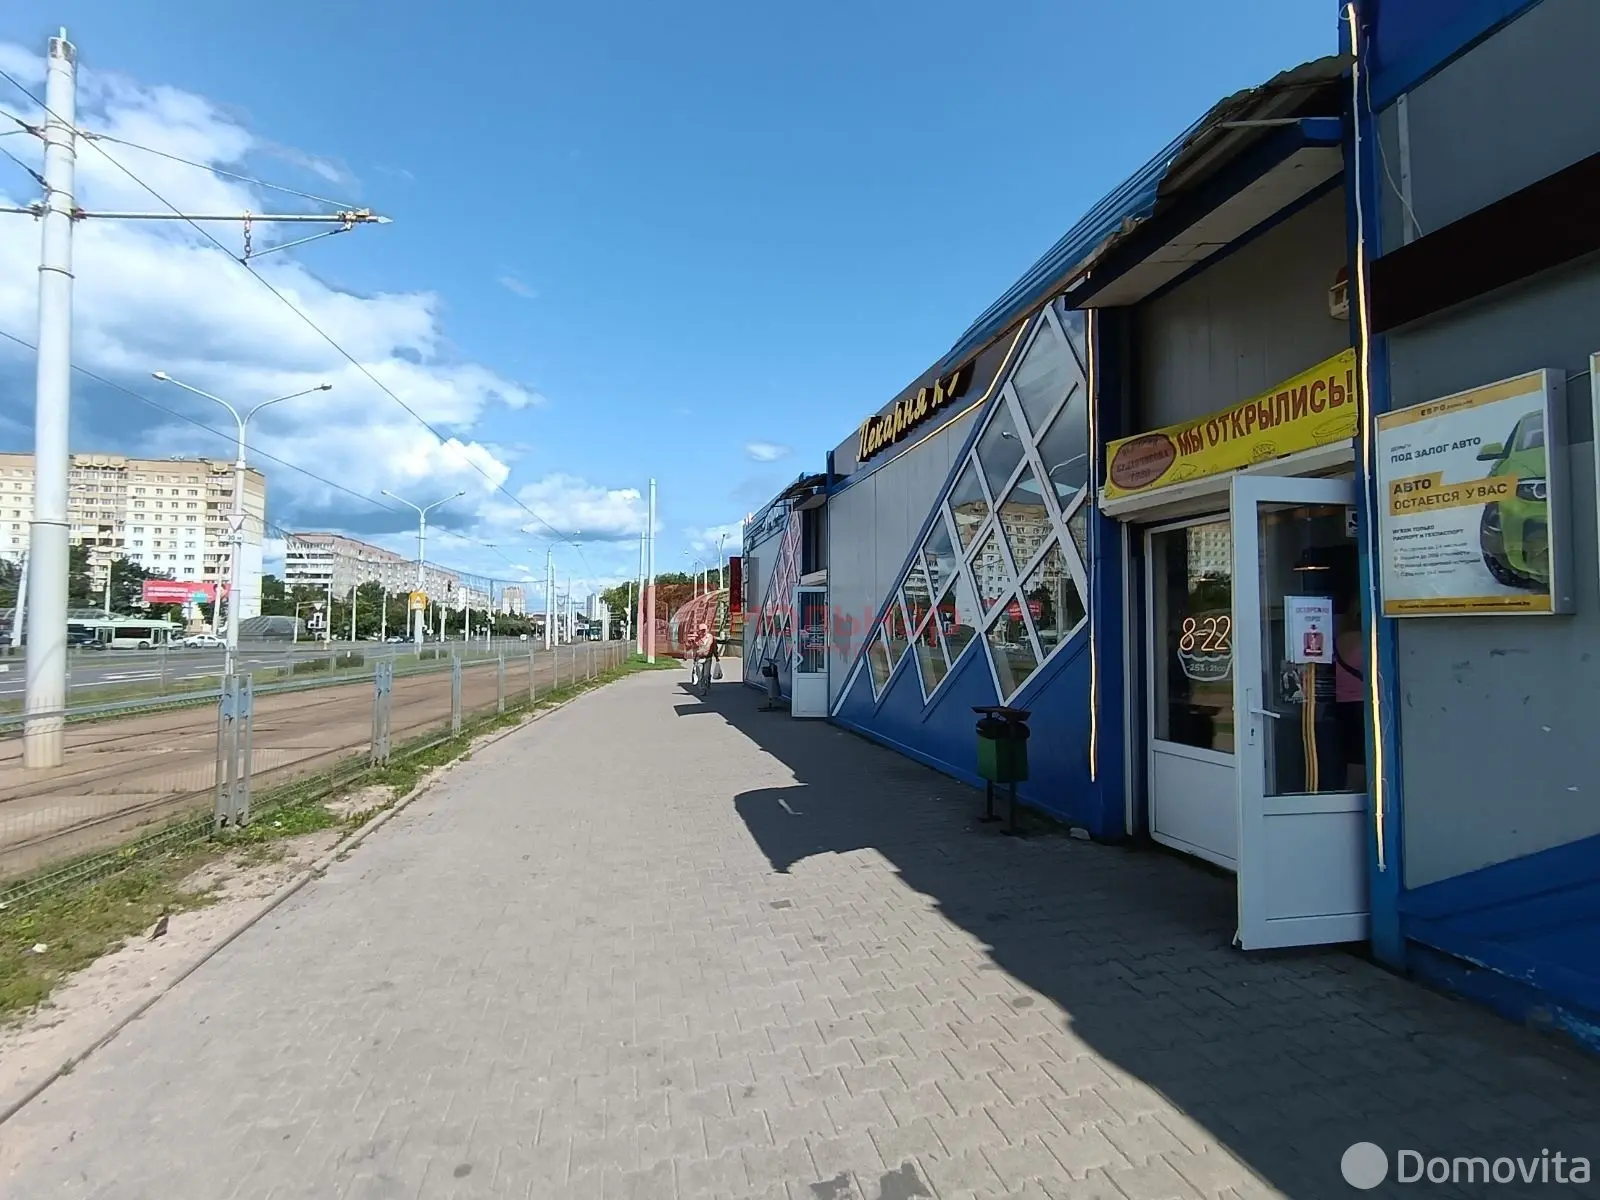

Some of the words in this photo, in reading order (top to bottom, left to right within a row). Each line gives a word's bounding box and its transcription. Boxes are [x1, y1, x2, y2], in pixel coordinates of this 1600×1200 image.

[855, 387, 928, 462] Пекарня
[1176, 424, 1204, 456] МЫ
[1205, 369, 1354, 446] ОТКРЫЛИСЬ!
[1391, 452, 1413, 464] ПОД
[1414, 443, 1450, 459] ЗАЛОГ
[1451, 436, 1481, 451] АВТО
[1393, 478, 1432, 495] АВТО
[1394, 491, 1460, 510] ОСТАЕТСЯ
[1465, 488, 1475, 499] У
[1477, 483, 1508, 497] ВАС
[1180, 615, 1231, 651] 8-22
